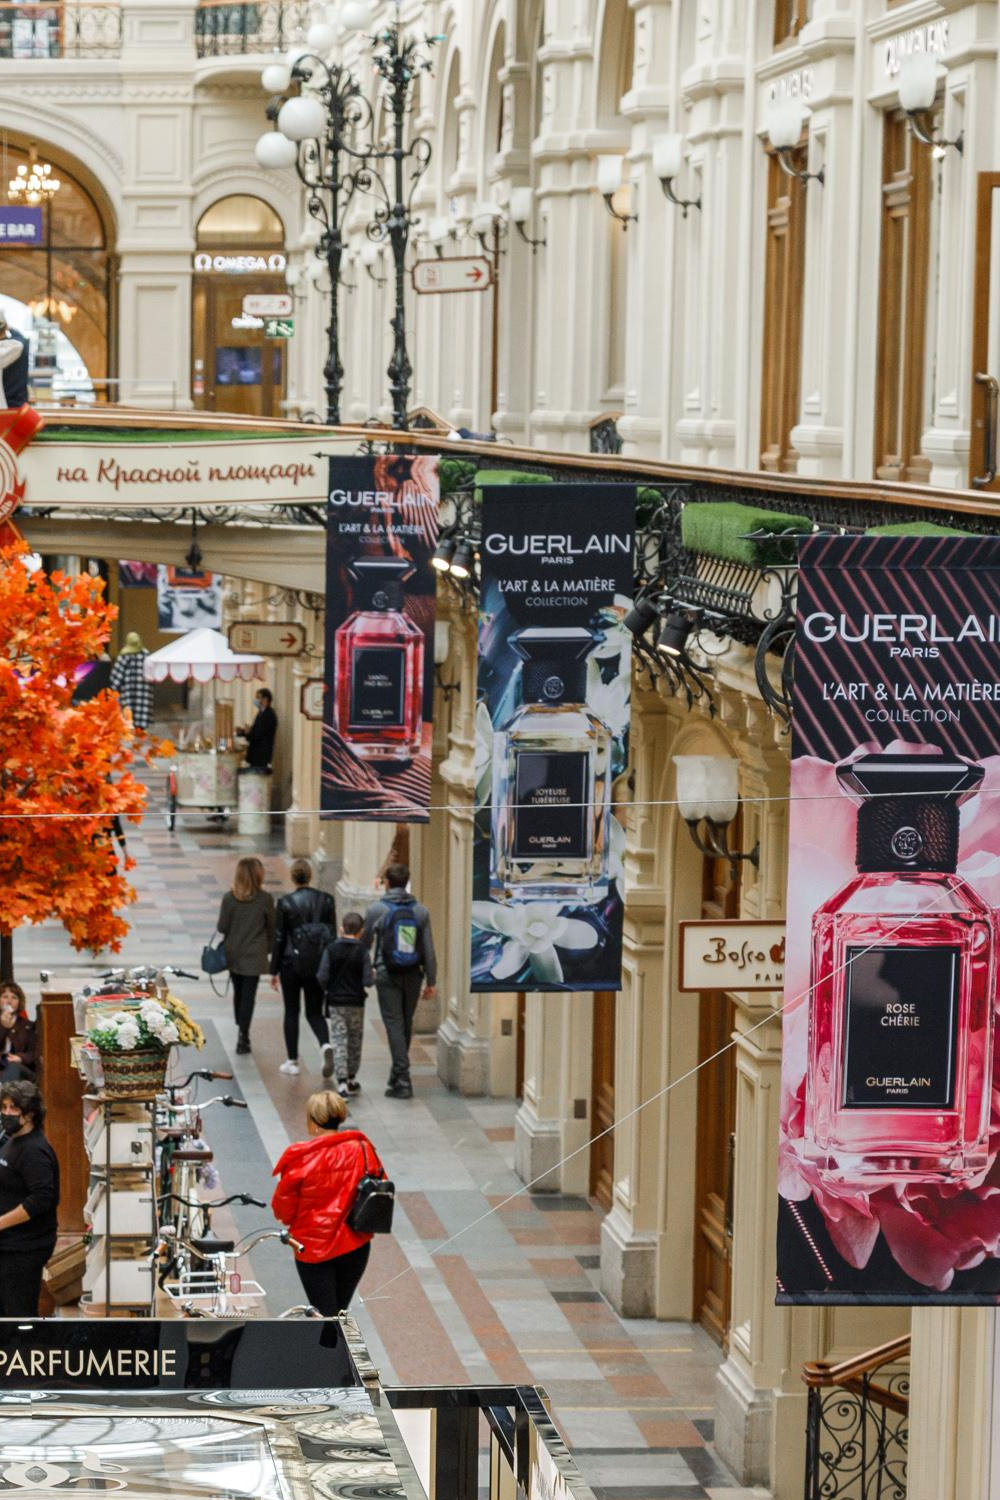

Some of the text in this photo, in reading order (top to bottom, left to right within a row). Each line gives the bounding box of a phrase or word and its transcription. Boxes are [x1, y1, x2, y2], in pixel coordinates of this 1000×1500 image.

[7, 223, 35, 236] BAR
[213, 256, 267, 272] OMEGA
[57, 458, 315, 490] на Красной площади
[330, 489, 437, 507] GUERLAIN
[373, 524, 384, 533] LA
[485, 534, 630, 554] GUERLAIN
[541, 556, 574, 564] PARIS
[498, 578, 616, 592] L'ART & LA MATIÈRE
[525, 597, 588, 607] COLLECTION
[803, 612, 1000, 642] GUERLAI
[890, 647, 940, 658] PARIS
[823, 682, 869, 700] L'ART
[874, 683, 888, 701] &
[894, 683, 917, 700] LA
[865, 709, 960, 722] COLLECTION
[702, 937, 766, 970] Bosco
[886, 1003, 915, 1014] ROSE
[881, 1014, 920, 1027] CHÉRIE
[866, 1077, 930, 1087] GUERLAIN
